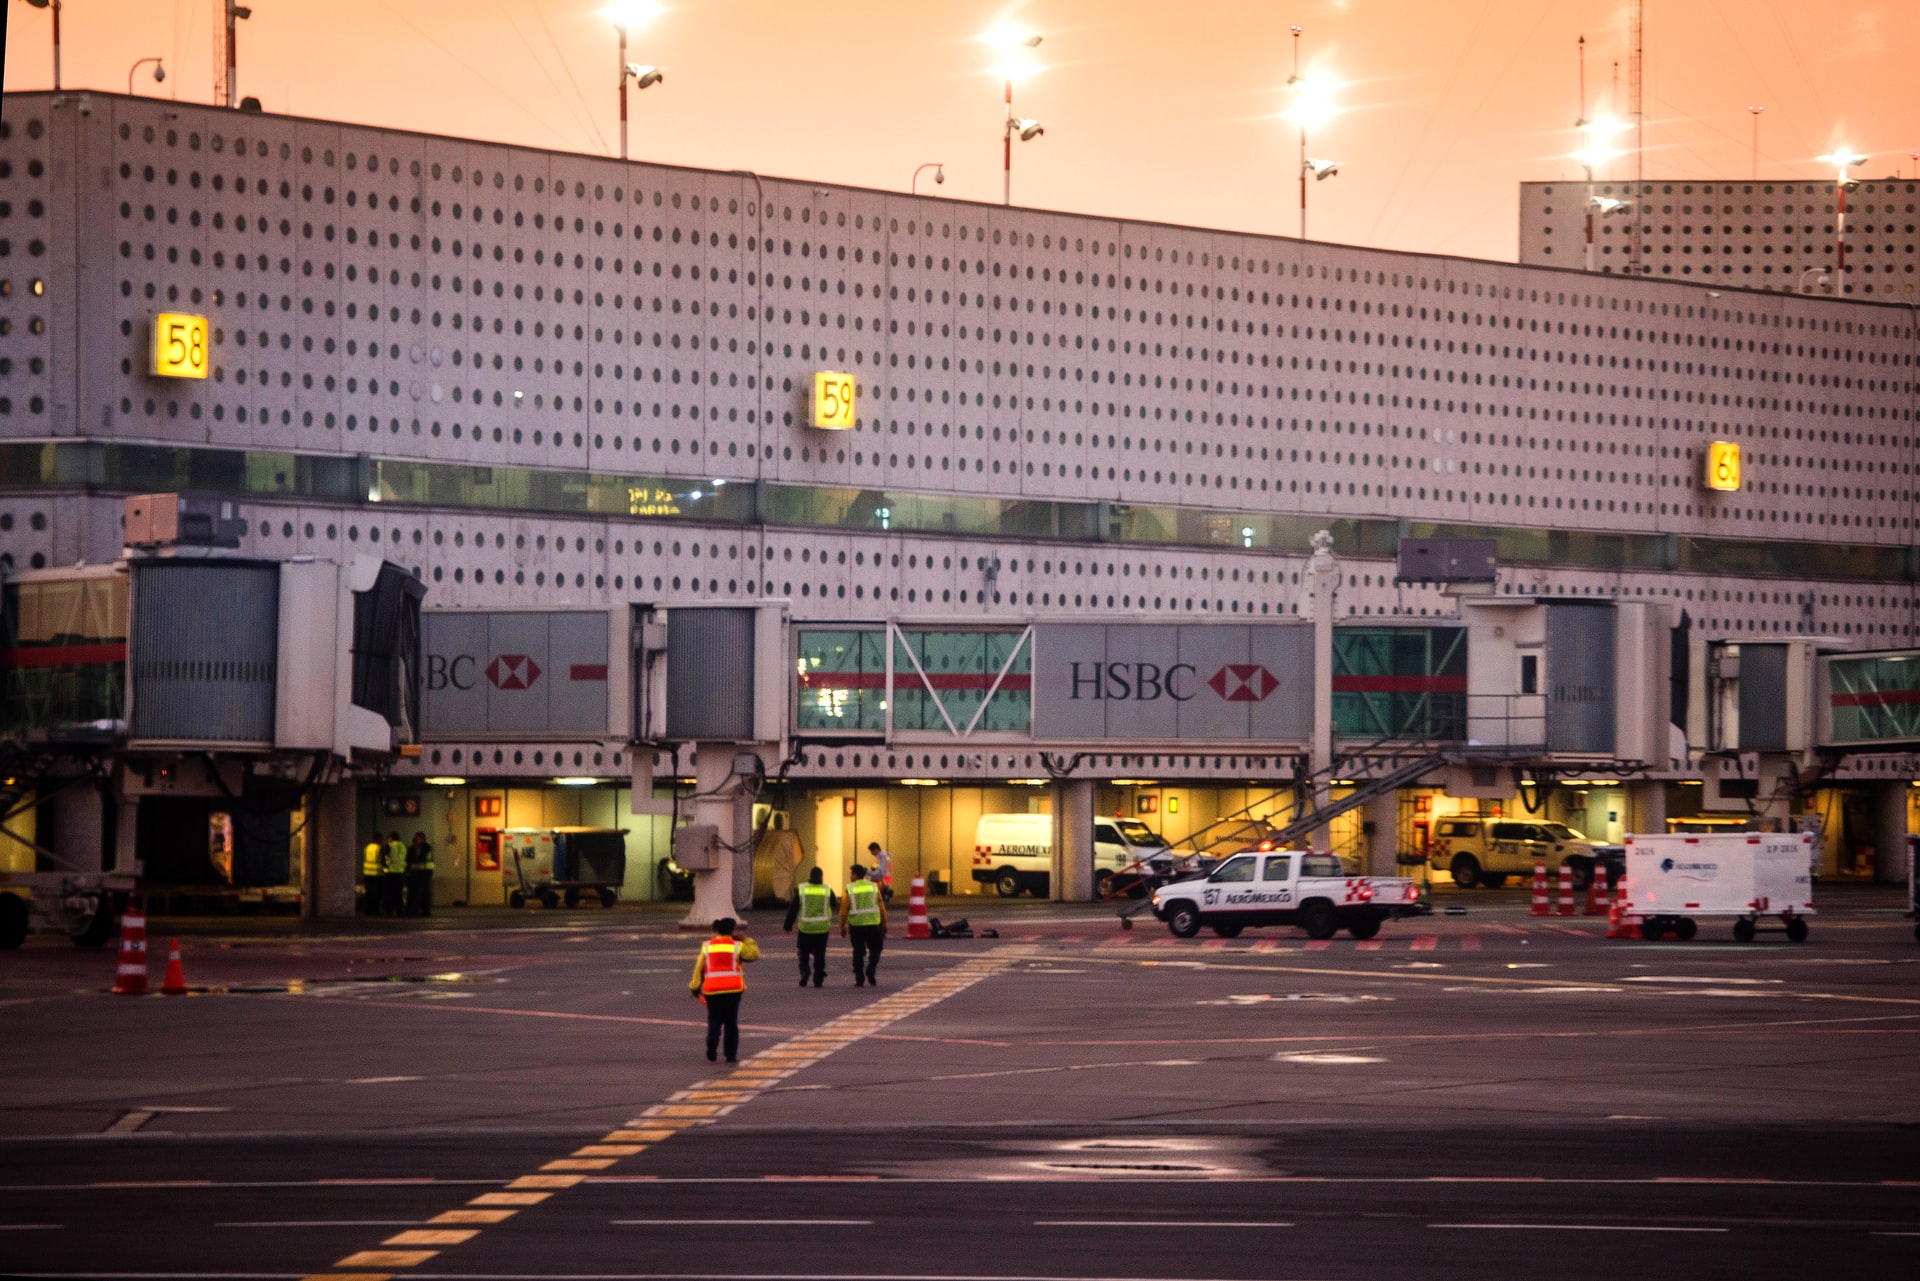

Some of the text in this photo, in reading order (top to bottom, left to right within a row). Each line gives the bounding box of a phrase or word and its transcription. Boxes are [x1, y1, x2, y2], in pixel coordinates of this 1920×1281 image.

[169, 324, 202, 367] 58
[822, 380, 851, 420] 59
[1716, 451, 1738, 482] 60
[1070, 661, 1197, 701] HSBC
[1203, 888, 1292, 905] 157 AEROMEXICO
